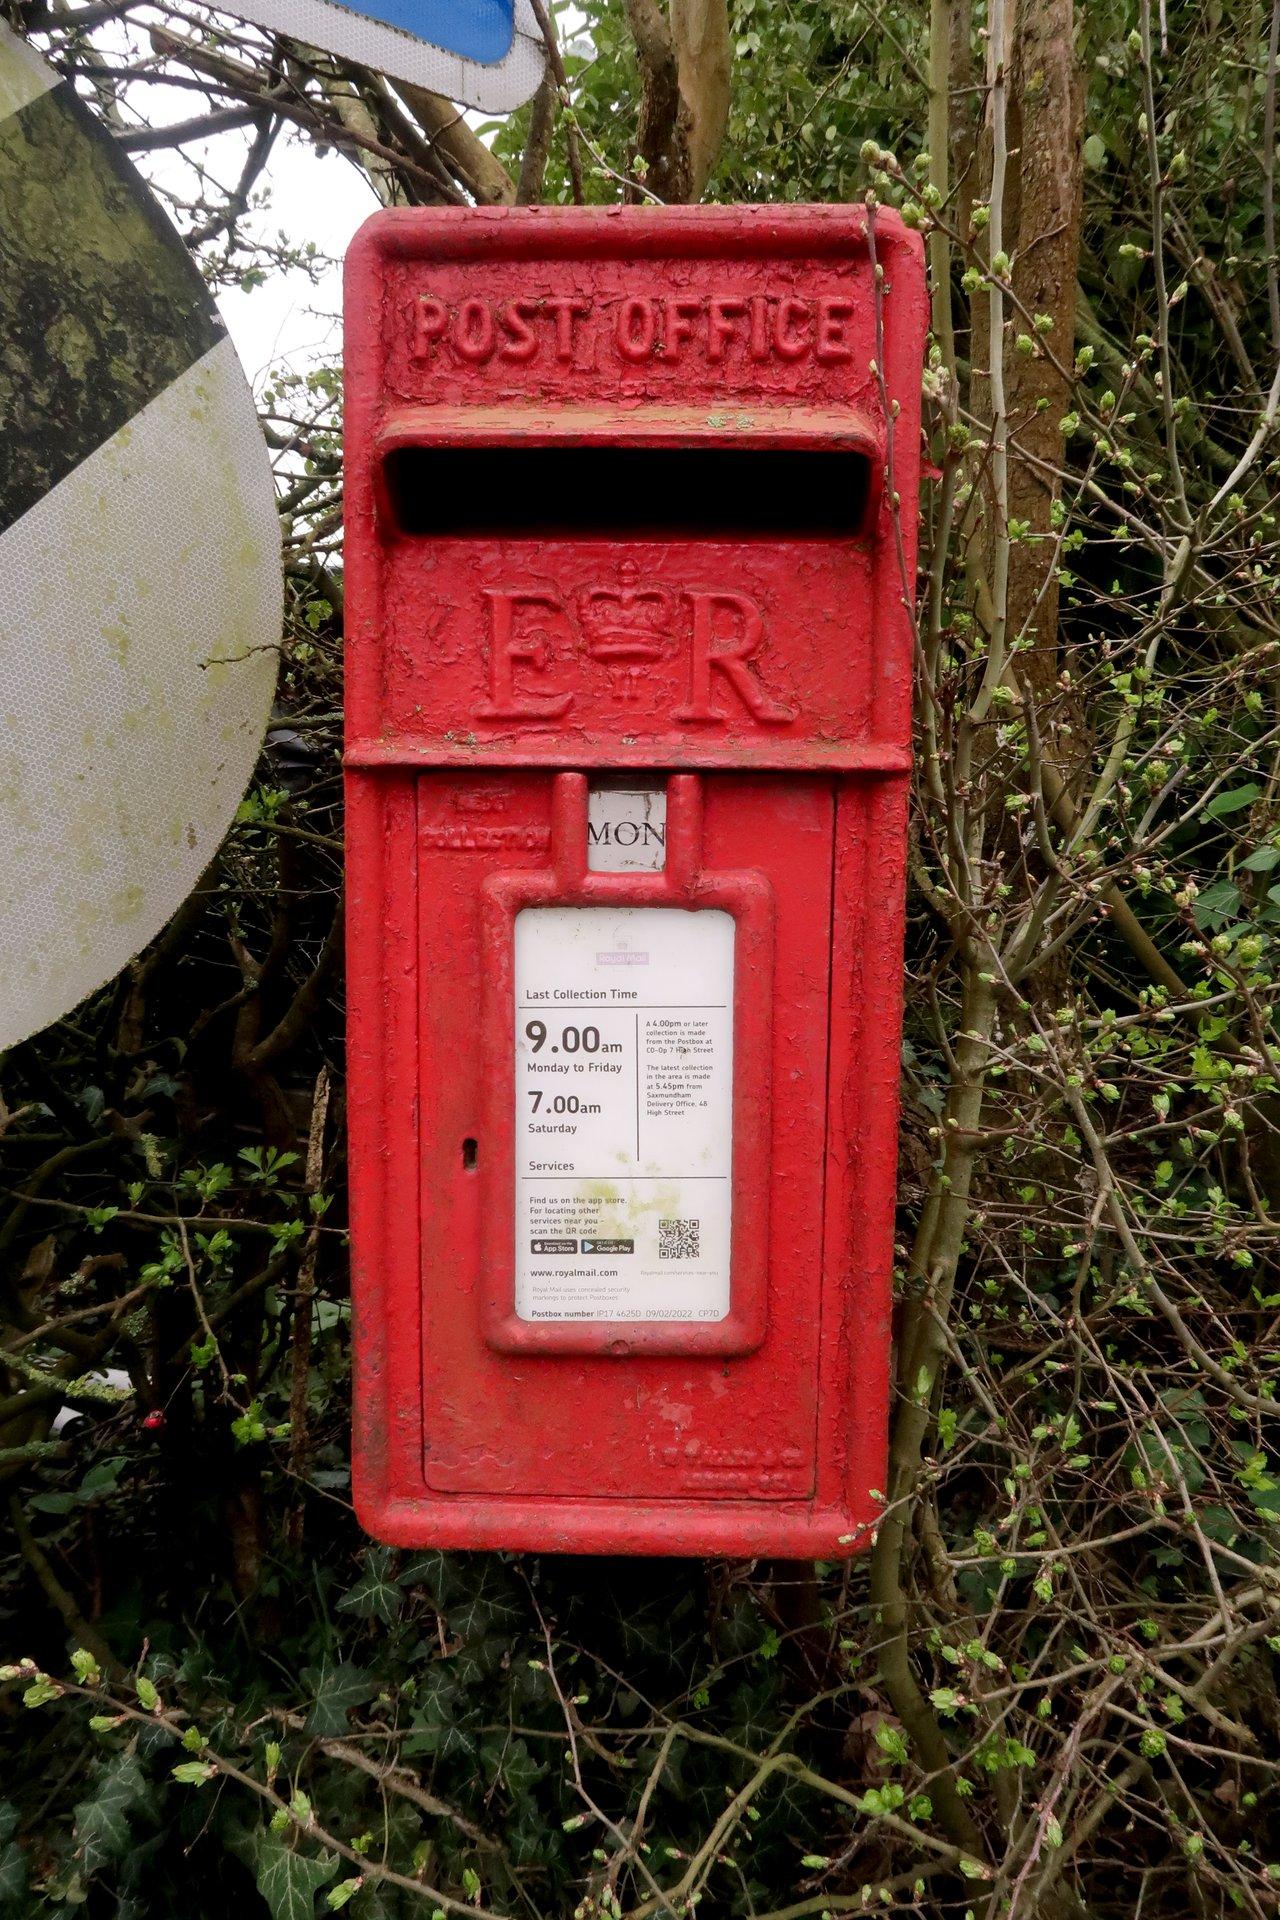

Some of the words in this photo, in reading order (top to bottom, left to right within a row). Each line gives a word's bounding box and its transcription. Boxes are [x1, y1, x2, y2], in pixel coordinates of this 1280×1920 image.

[412, 297, 596, 365] POST
[616, 297, 853, 365] OFFICE
[471, 586, 575, 721] E
[671, 588, 799, 725] R
[587, 821, 666, 846] MON
[526, 990, 550, 999] Last
[553, 989, 606, 999] Collection
[610, 989, 637, 999] Time
[653, 1020, 681, 1028] 4.00pm
[525, 1020, 622, 1053] 9.00am
[528, 1063, 569, 1074] Monday
[573, 1064, 584, 1072] to
[589, 1062, 622, 1074] Friday
[655, 1083, 684, 1091] 5.45pm
[528, 1091, 601, 1114] 7.00am
[528, 1123, 577, 1135] Saturday
[529, 1161, 574, 1170] Services
[545, 1207, 576, 1215] locating
[530, 1268, 618, 1278] www.royalmail.com
[531, 1310, 562, 1318] Postbox
[564, 1310, 594, 1318] number
[646, 1310, 692, 1318] 09/02/2022
